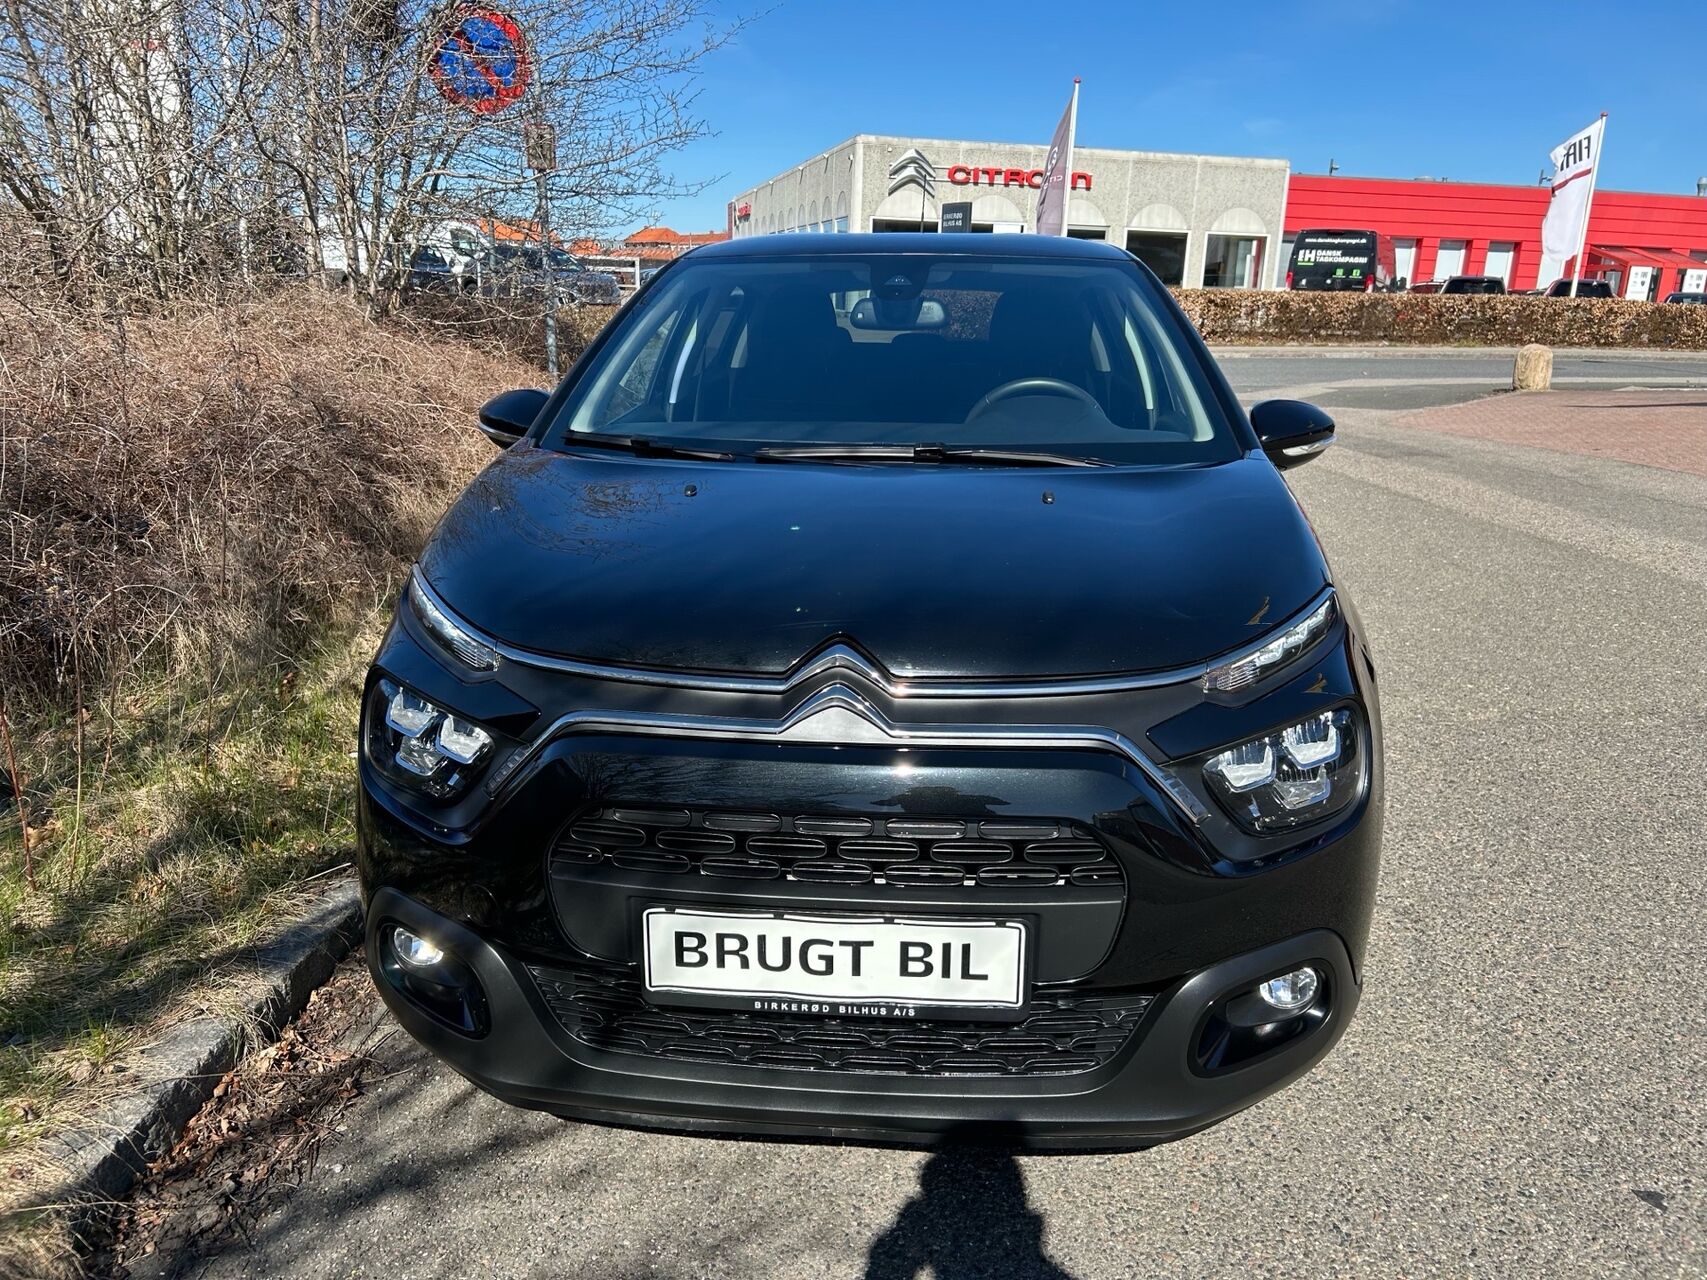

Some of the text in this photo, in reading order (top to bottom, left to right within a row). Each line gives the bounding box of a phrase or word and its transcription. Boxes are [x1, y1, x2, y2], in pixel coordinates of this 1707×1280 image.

[947, 164, 1093, 191] CITRON
[1316, 256, 1368, 264] TAGKOMPAGNI
[674, 931, 989, 981] BRUGT BIL
[754, 1001, 916, 1018] BIRKERØD BILHUS A/S
